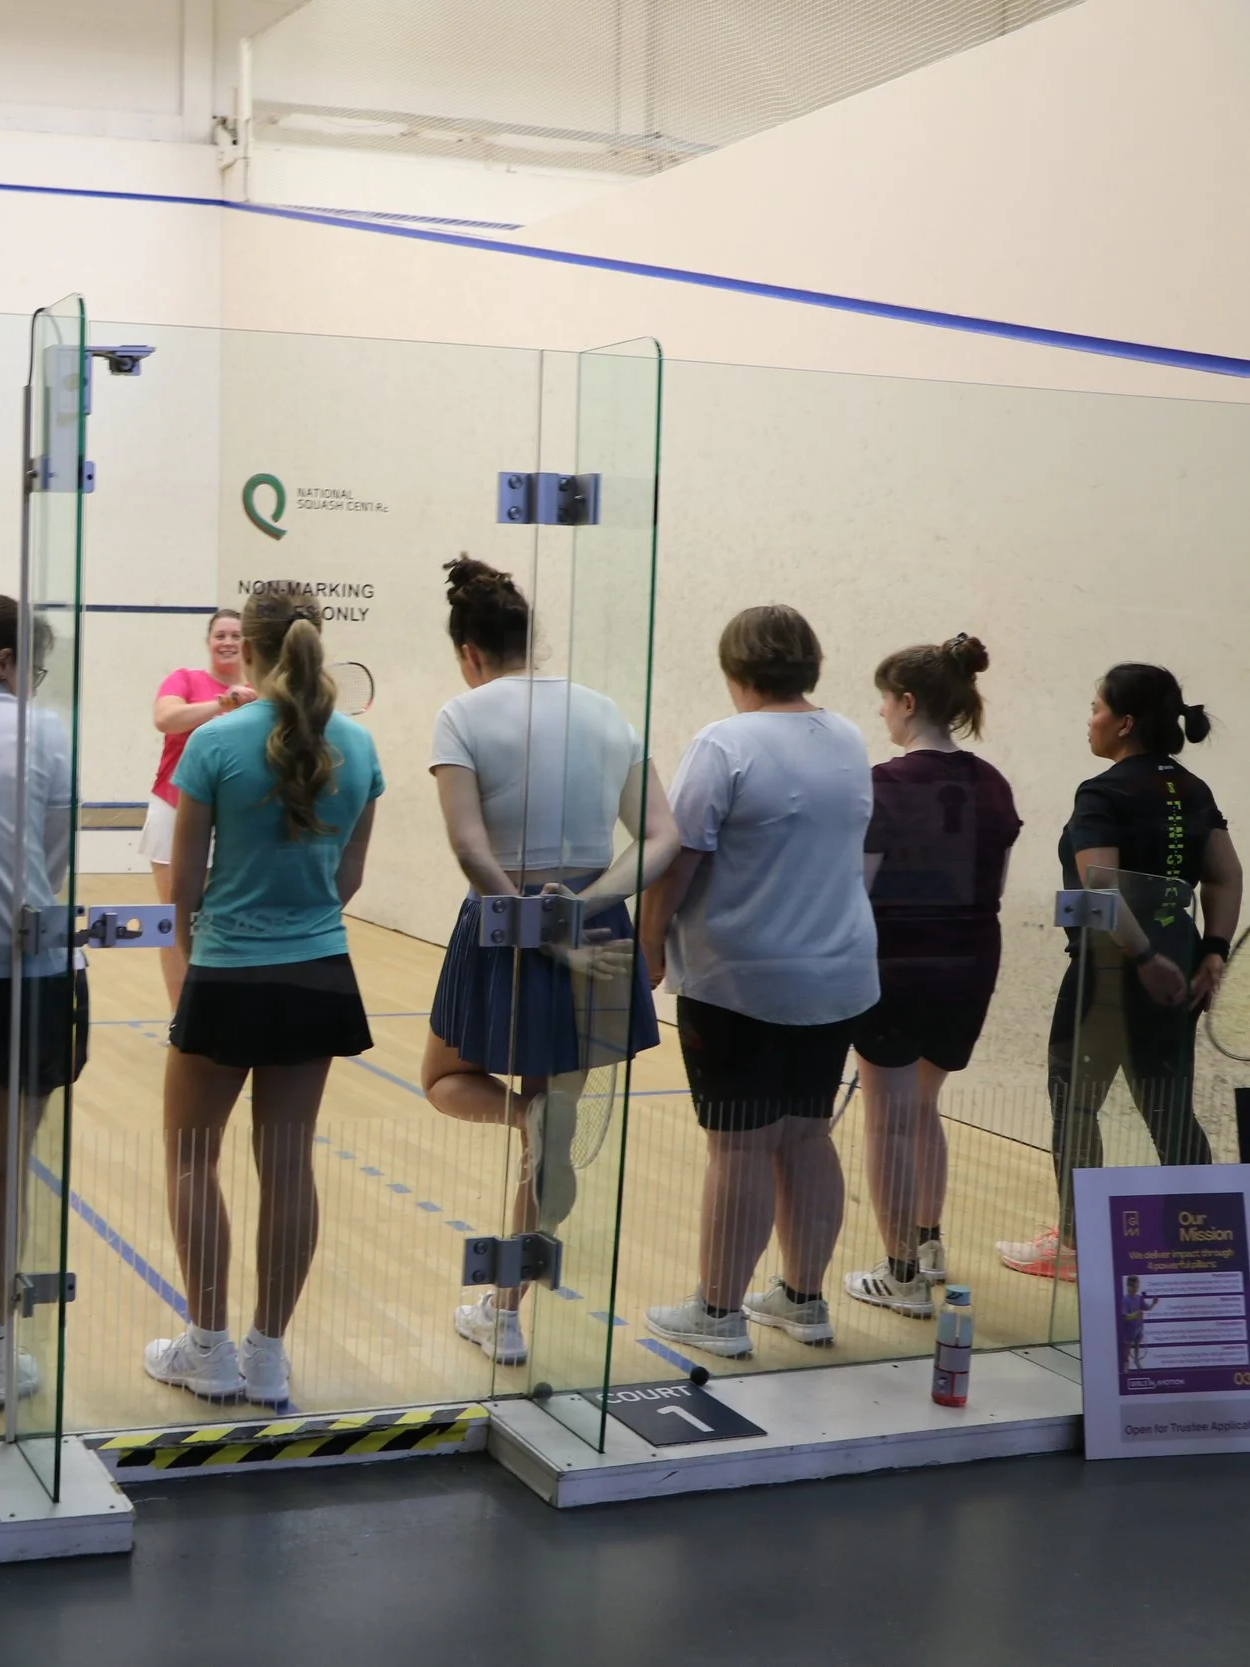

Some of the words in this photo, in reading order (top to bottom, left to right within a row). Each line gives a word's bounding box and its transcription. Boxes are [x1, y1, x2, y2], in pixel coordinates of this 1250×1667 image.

[297, 487, 354, 500] NATIONAL
[296, 499, 344, 511] SQUASH
[238, 580, 375, 599] NON-MARKING
[321, 606, 370, 622] ONLY
[1178, 1211, 1207, 1226] Our
[1179, 1226, 1233, 1242] Mission
[596, 1385, 692, 1404] COURT
[657, 1405, 714, 1433] 1
[1125, 1424, 1152, 1436] Open
[1154, 1423, 1168, 1433] for
[1170, 1422, 1208, 1433] Trustee
